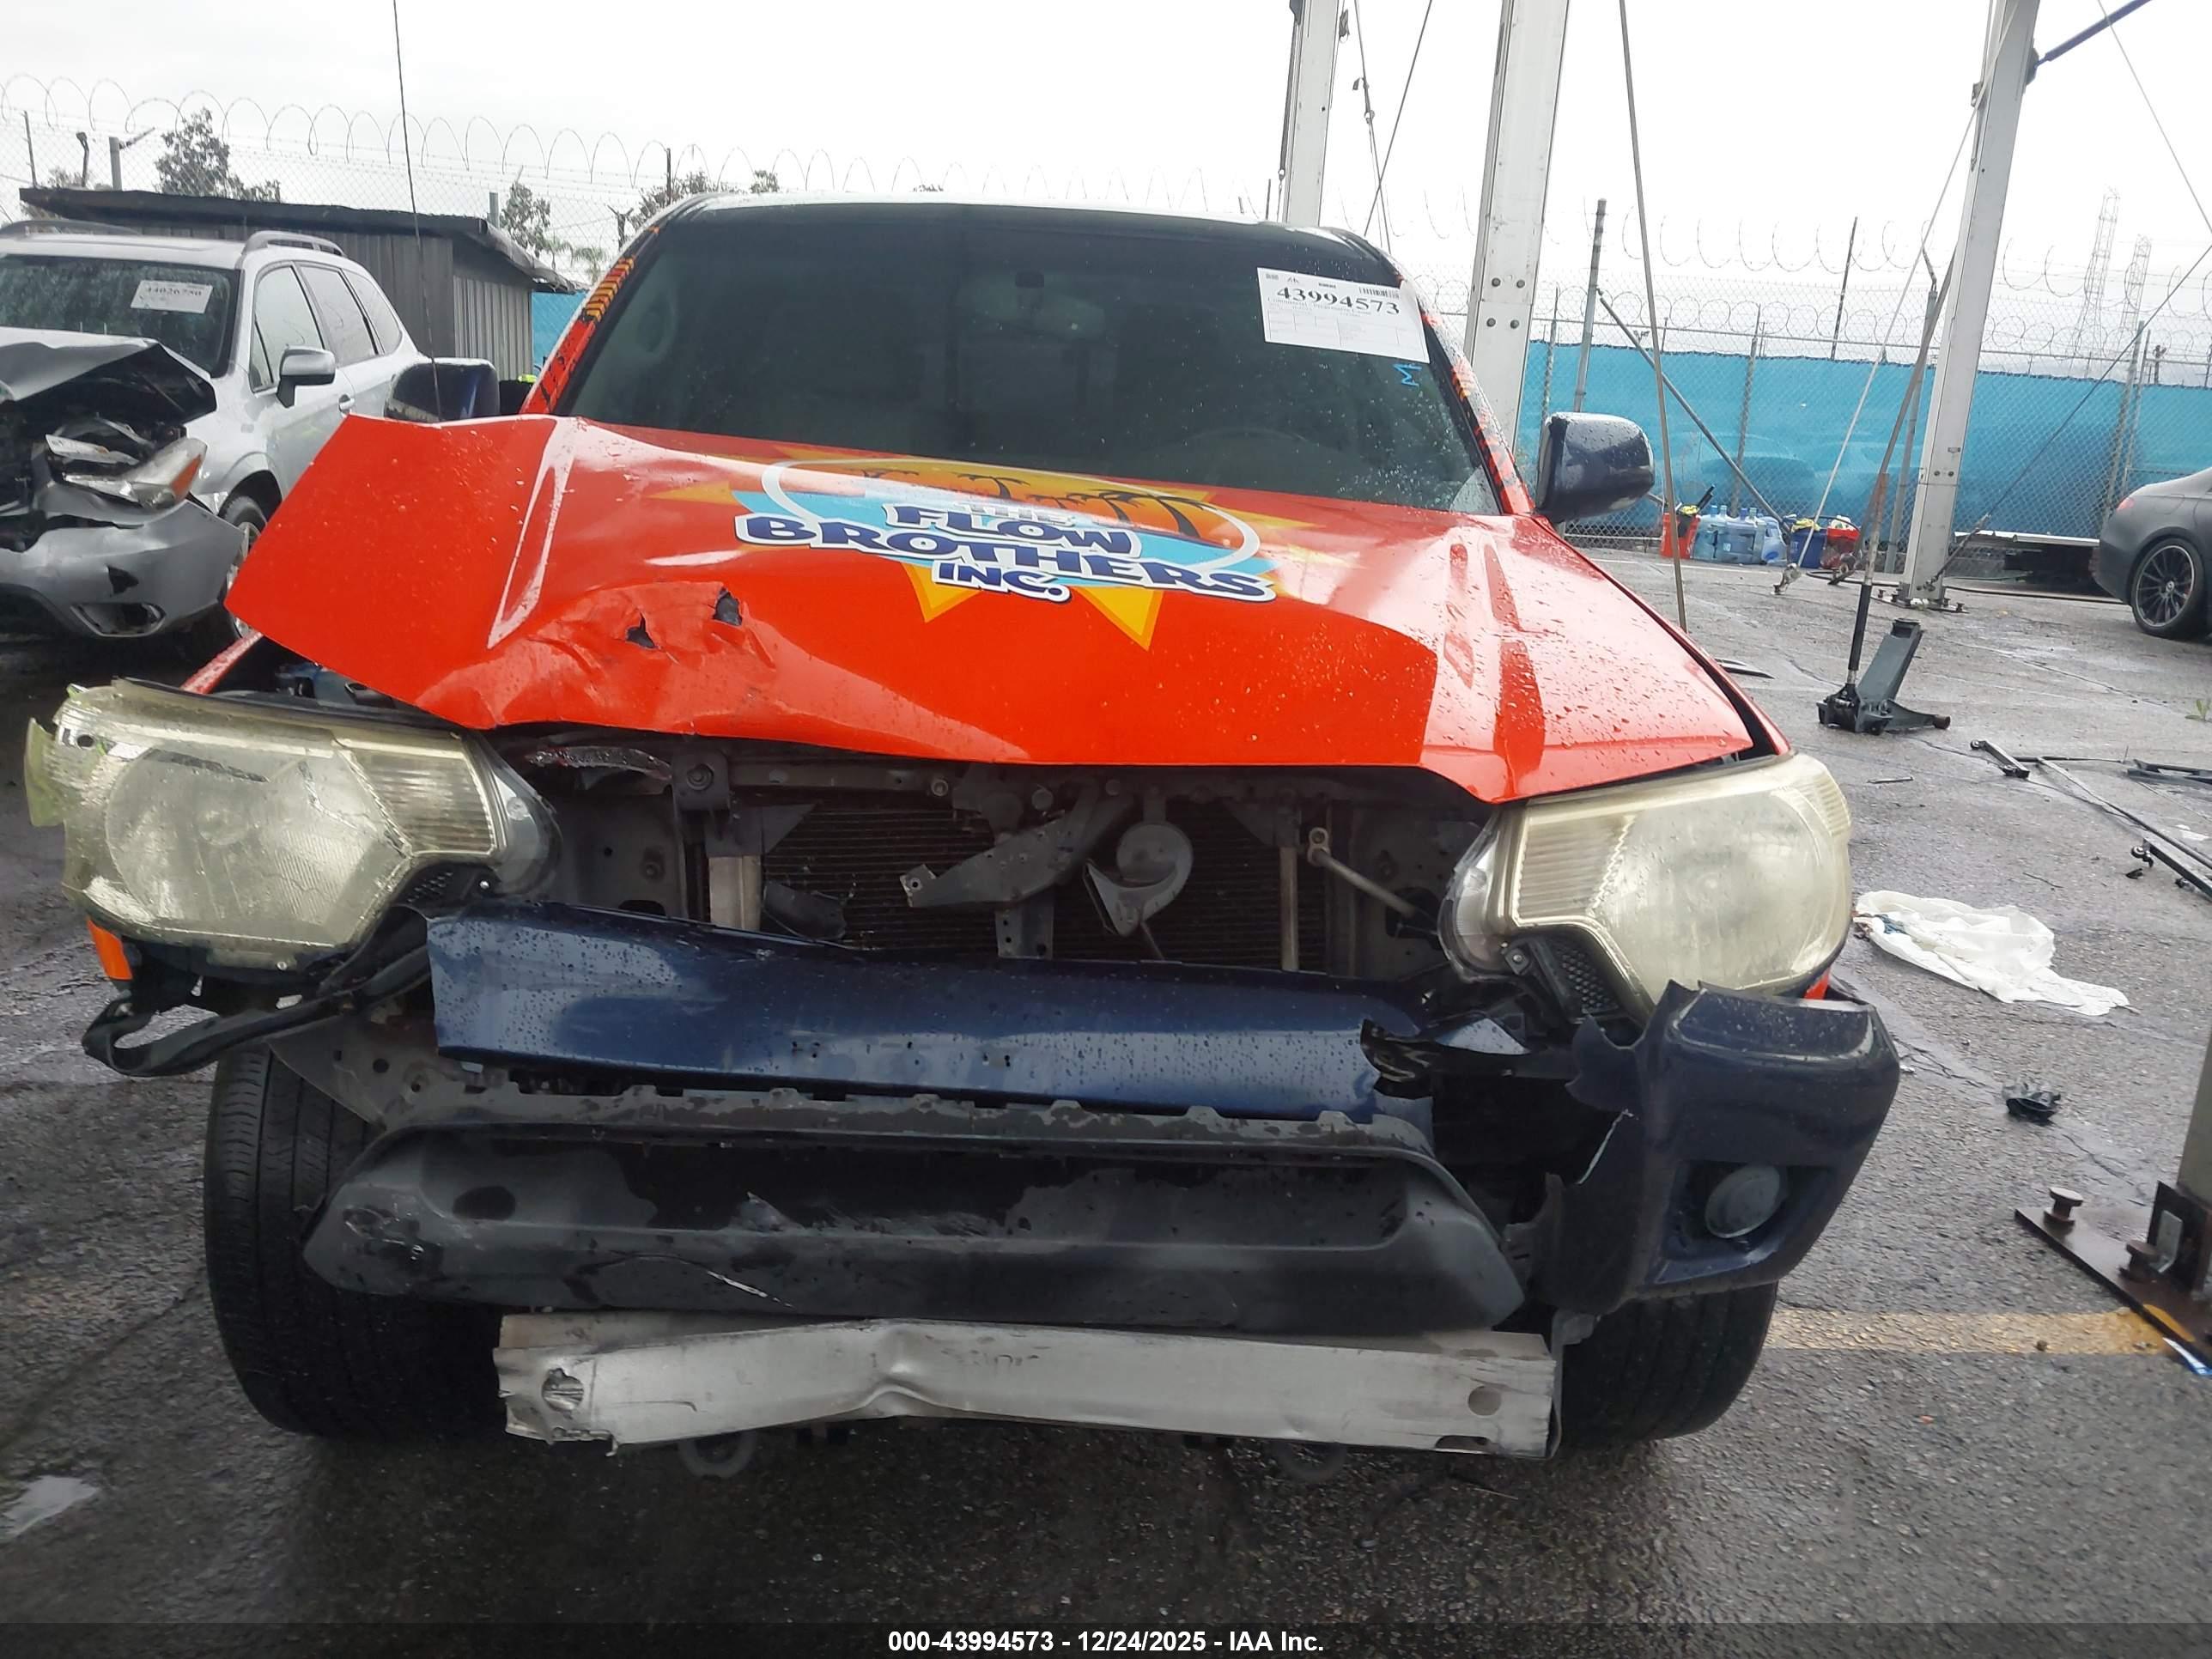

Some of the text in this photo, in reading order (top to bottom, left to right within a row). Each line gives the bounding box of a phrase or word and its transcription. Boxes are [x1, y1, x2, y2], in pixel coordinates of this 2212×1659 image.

[1277, 287, 1401, 315] 43994573
[890, 504, 1135, 555] FLOW
[742, 514, 1271, 597] BROTHERS
[936, 562, 1066, 599] INC.
